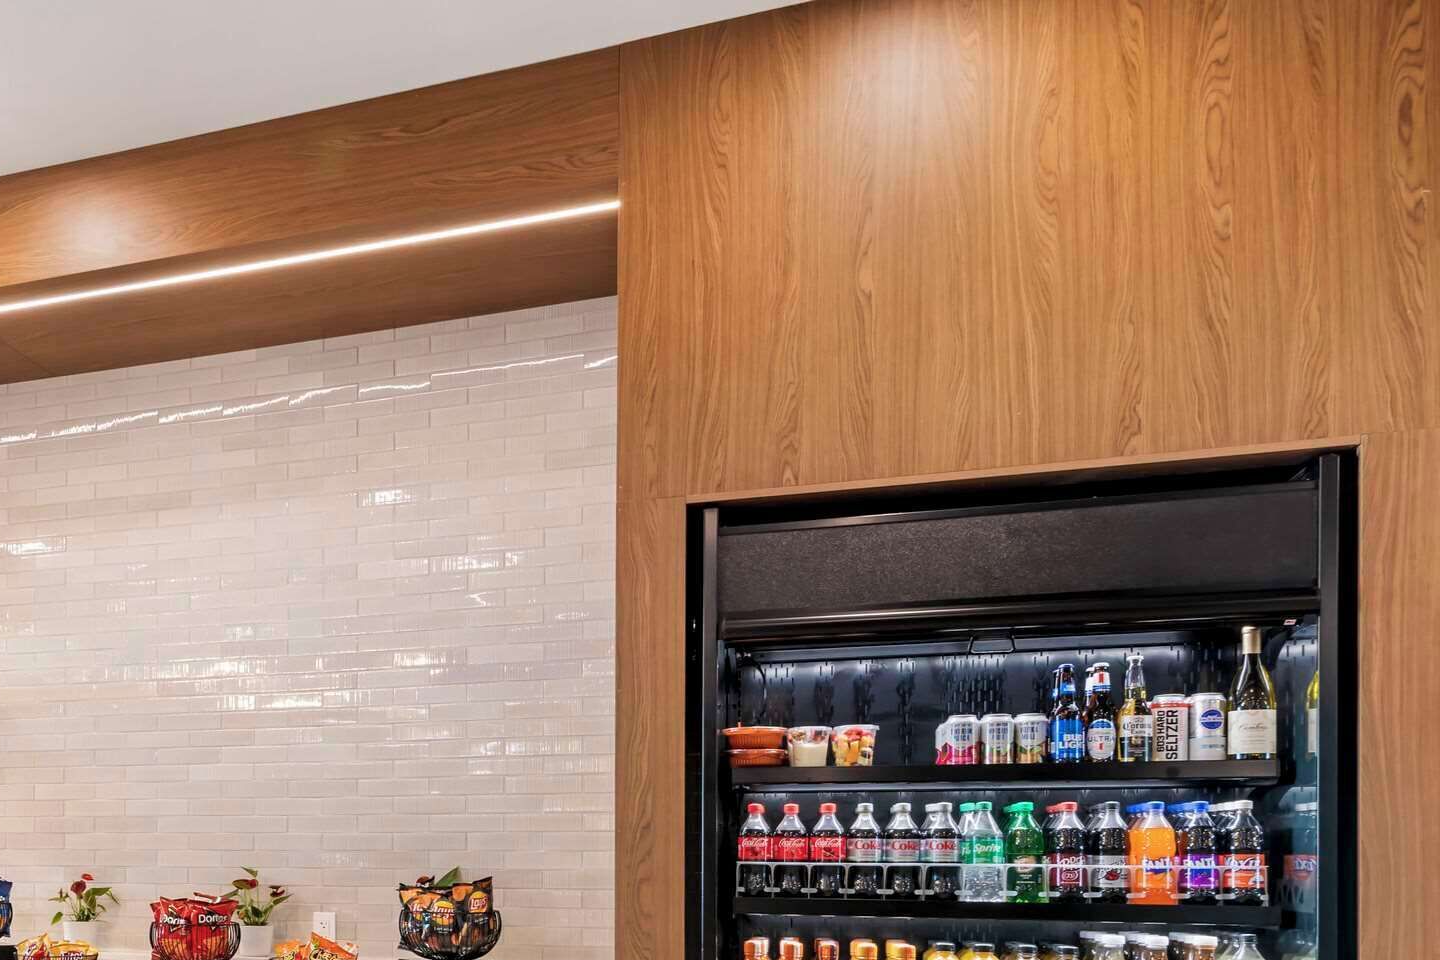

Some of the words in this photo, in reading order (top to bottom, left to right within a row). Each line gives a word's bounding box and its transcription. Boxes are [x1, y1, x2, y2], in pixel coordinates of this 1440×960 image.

[1165, 710, 1179, 760] SELTZER
[1059, 741, 1085, 749] LIGH
[975, 844, 1001, 853] Sprite
[198, 914, 228, 924] Doritos
